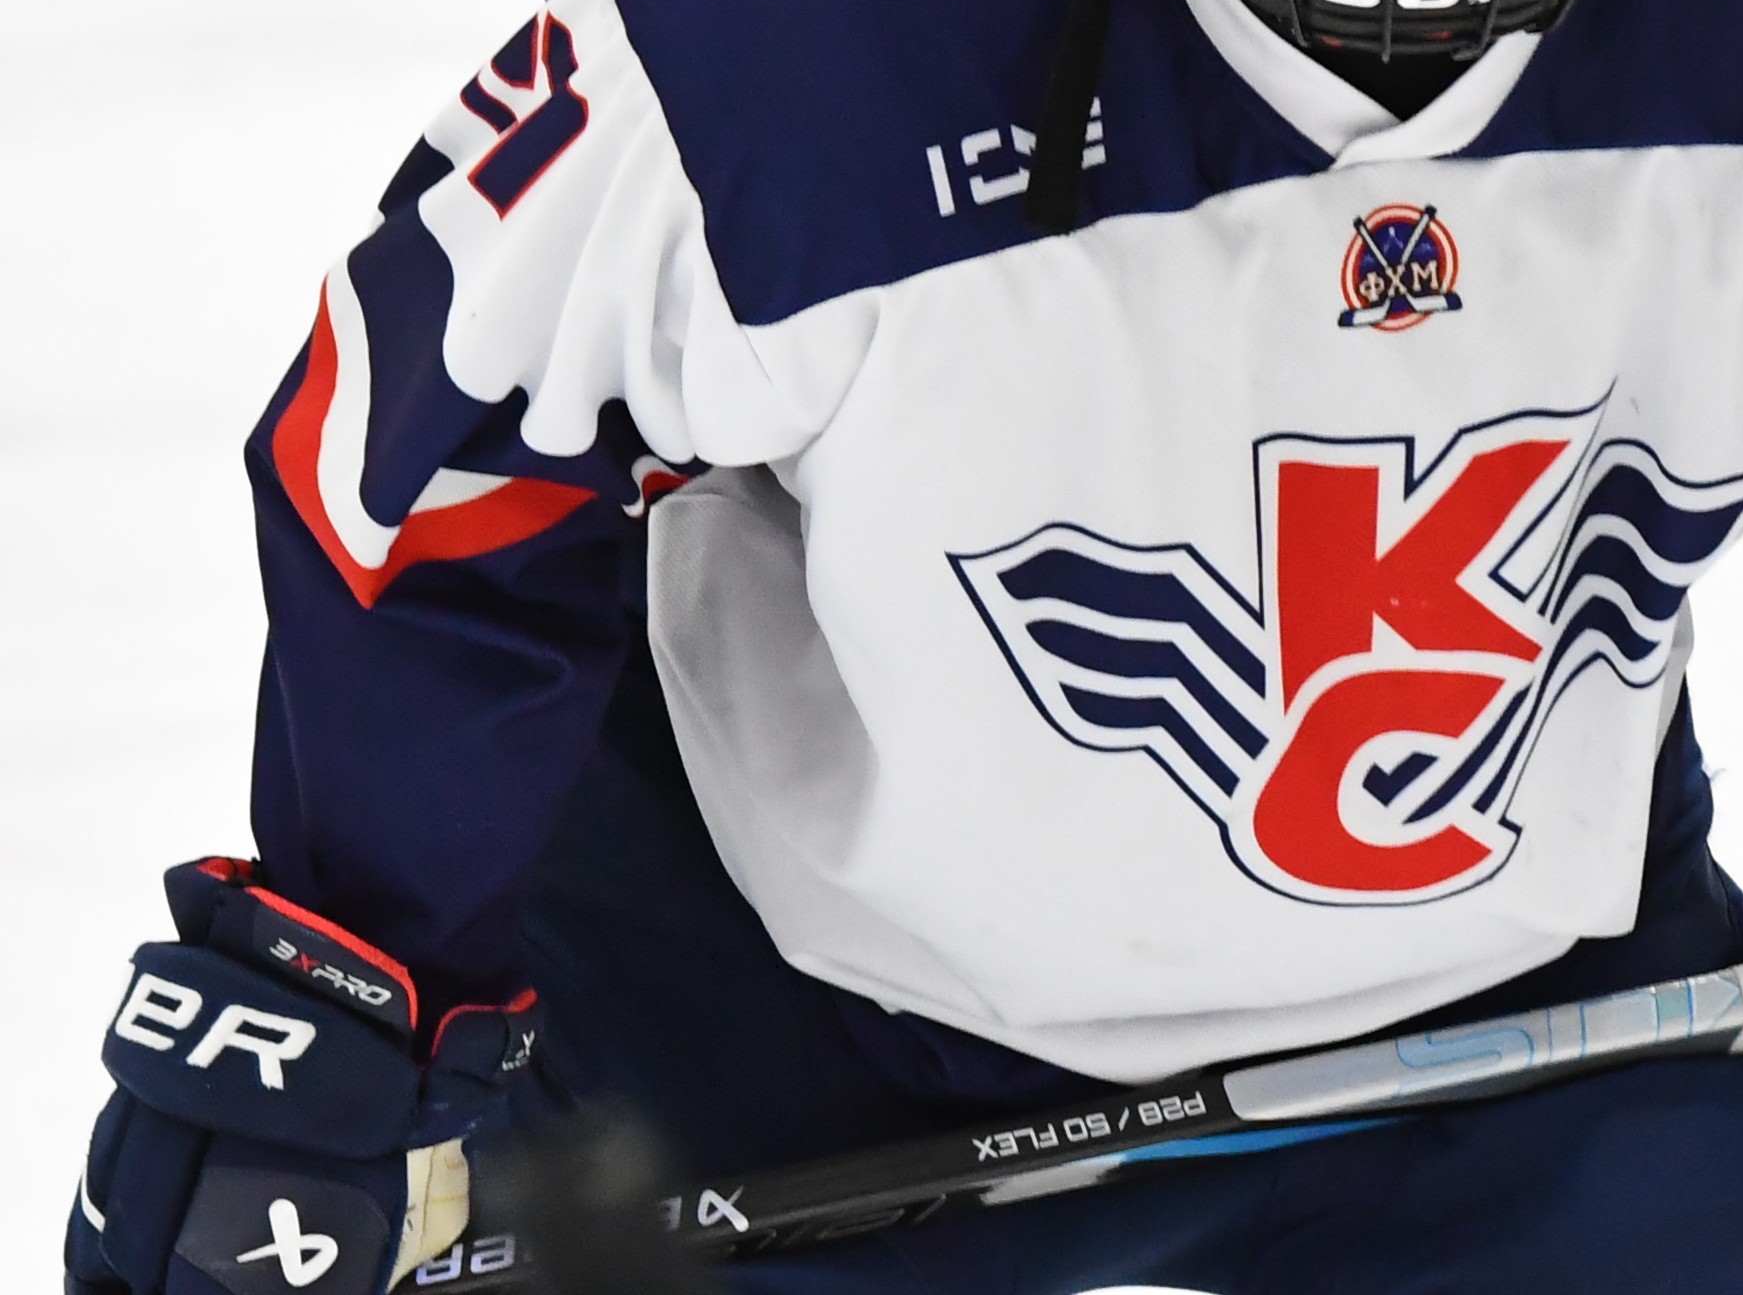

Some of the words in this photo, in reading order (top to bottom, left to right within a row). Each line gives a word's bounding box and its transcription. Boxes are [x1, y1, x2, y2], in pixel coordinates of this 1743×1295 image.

[268, 937, 392, 1006] 3XPRO
[1137, 1090, 1207, 1127] P28
[971, 1122, 1060, 1163] FLEX
